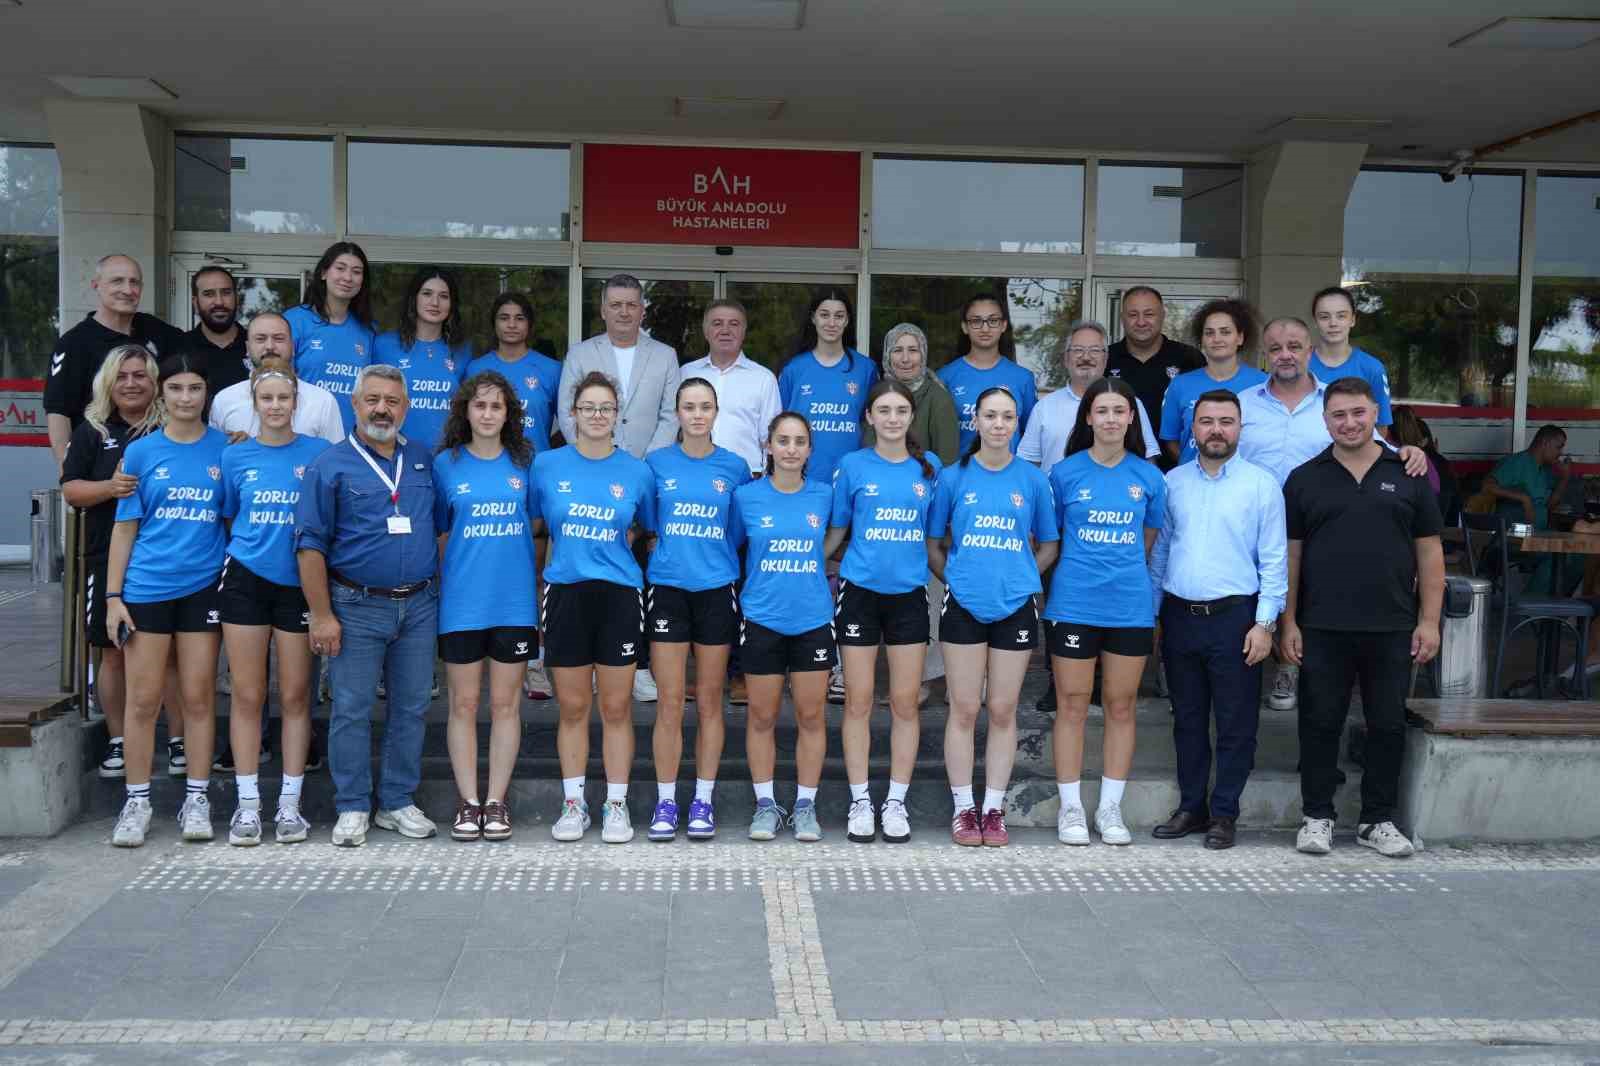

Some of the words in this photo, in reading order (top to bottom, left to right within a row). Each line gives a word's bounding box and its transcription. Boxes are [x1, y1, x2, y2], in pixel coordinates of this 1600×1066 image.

[656, 197, 706, 213] BÜYÜK
[712, 201, 787, 215] ANADOLU
[412, 379, 451, 392] ZORLU
[810, 402, 849, 415] ZORLU
[167, 486, 213, 502] ZORLU
[252, 490, 300, 504] ZORLU
[471, 502, 516, 517] ZORLU
[568, 502, 616, 521] ZORLU
[673, 502, 718, 518] ZORLU
[874, 508, 918, 522] ZORLU
[1087, 509, 1134, 524] ZORLU
[974, 515, 1016, 530] ZORLU
[1078, 527, 1136, 545] OKULLAR
[769, 539, 814, 553] ZORLU
[760, 559, 817, 573] OKULLAR
